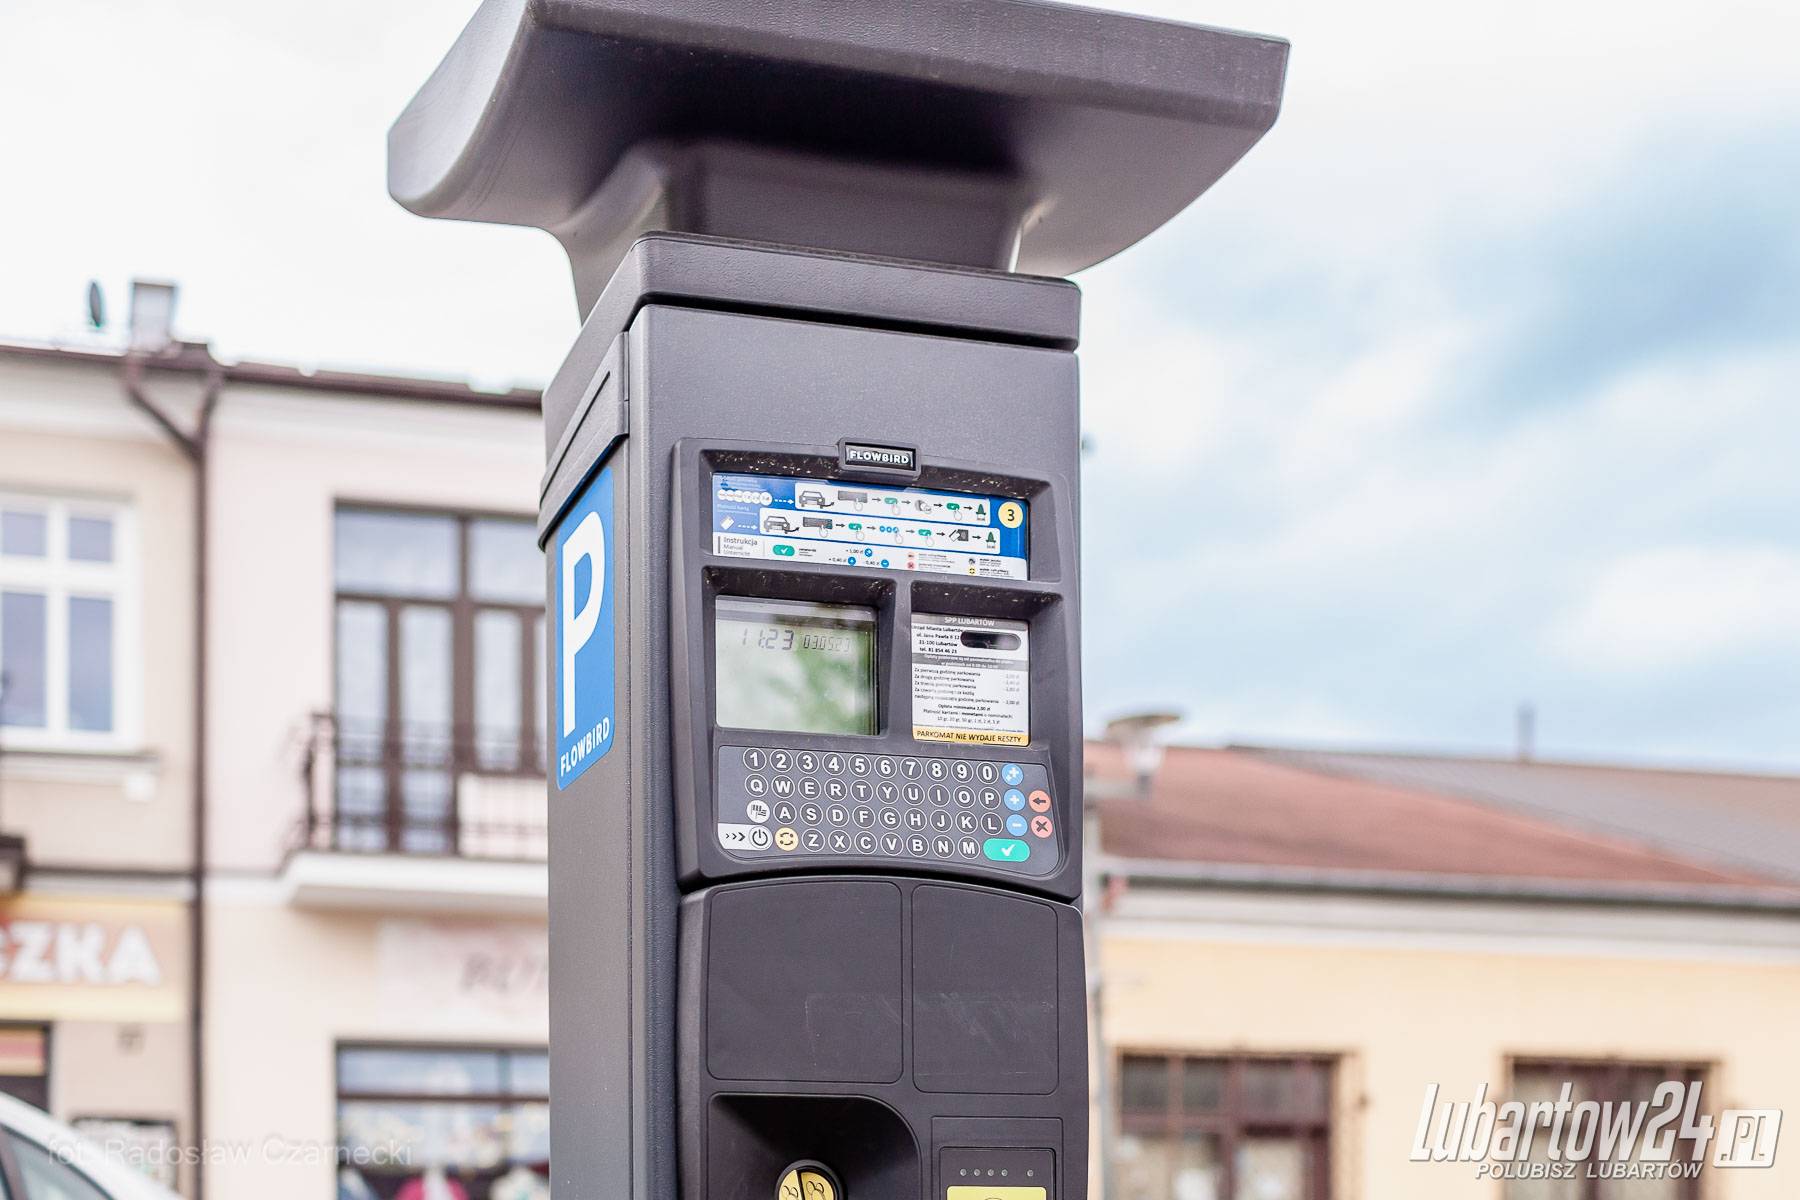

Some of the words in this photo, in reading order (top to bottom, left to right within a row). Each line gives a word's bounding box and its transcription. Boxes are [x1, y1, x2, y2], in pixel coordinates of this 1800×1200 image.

[850, 450, 909, 464] FLOWBIRD
[1008, 509, 1015, 522] 3
[724, 536, 758, 546] Instrukcja
[562, 512, 605, 738] P
[958, 617, 995, 626] LUBARTÓW
[560, 716, 610, 778] FLOWBIRD
[916, 730, 954, 739] PARKOMAT
[968, 734, 996, 742] WYDAJE
[750, 752, 758, 766] 1
[776, 754, 786, 768] 2
[802, 754, 814, 770] 3
[828, 756, 840, 772] 4
[854, 758, 866, 772] 5
[880, 760, 892, 774] 6
[906, 762, 916, 776] 7
[932, 762, 942, 778] 8
[956, 764, 968, 778] 9
[982, 766, 992, 780] 0
[750, 778, 764, 792] Q
[774, 780, 790, 794] W
[804, 782, 816, 794] E
[830, 784, 842, 796] R
[856, 784, 868, 798] T
[882, 786, 892, 800] Y
[908, 788, 918, 800] U
[958, 790, 970, 804] O
[984, 792, 994, 806] P
[780, 806, 792, 820] A
[806, 808, 818, 820] S
[832, 810, 844, 822] D
[858, 810, 868, 824] F
[884, 812, 896, 824] G
[910, 814, 922, 826] H
[936, 814, 946, 828] J
[960, 816, 972, 828] K
[988, 818, 998, 830] L
[808, 834, 820, 846] Z
[834, 834, 846, 848] X
[860, 836, 872, 850] C
[886, 838, 898, 850] V
[912, 838, 924, 852] B
[938, 840, 948, 854] N
[962, 842, 976, 854] M
[0, 922, 161, 986] ZKA
